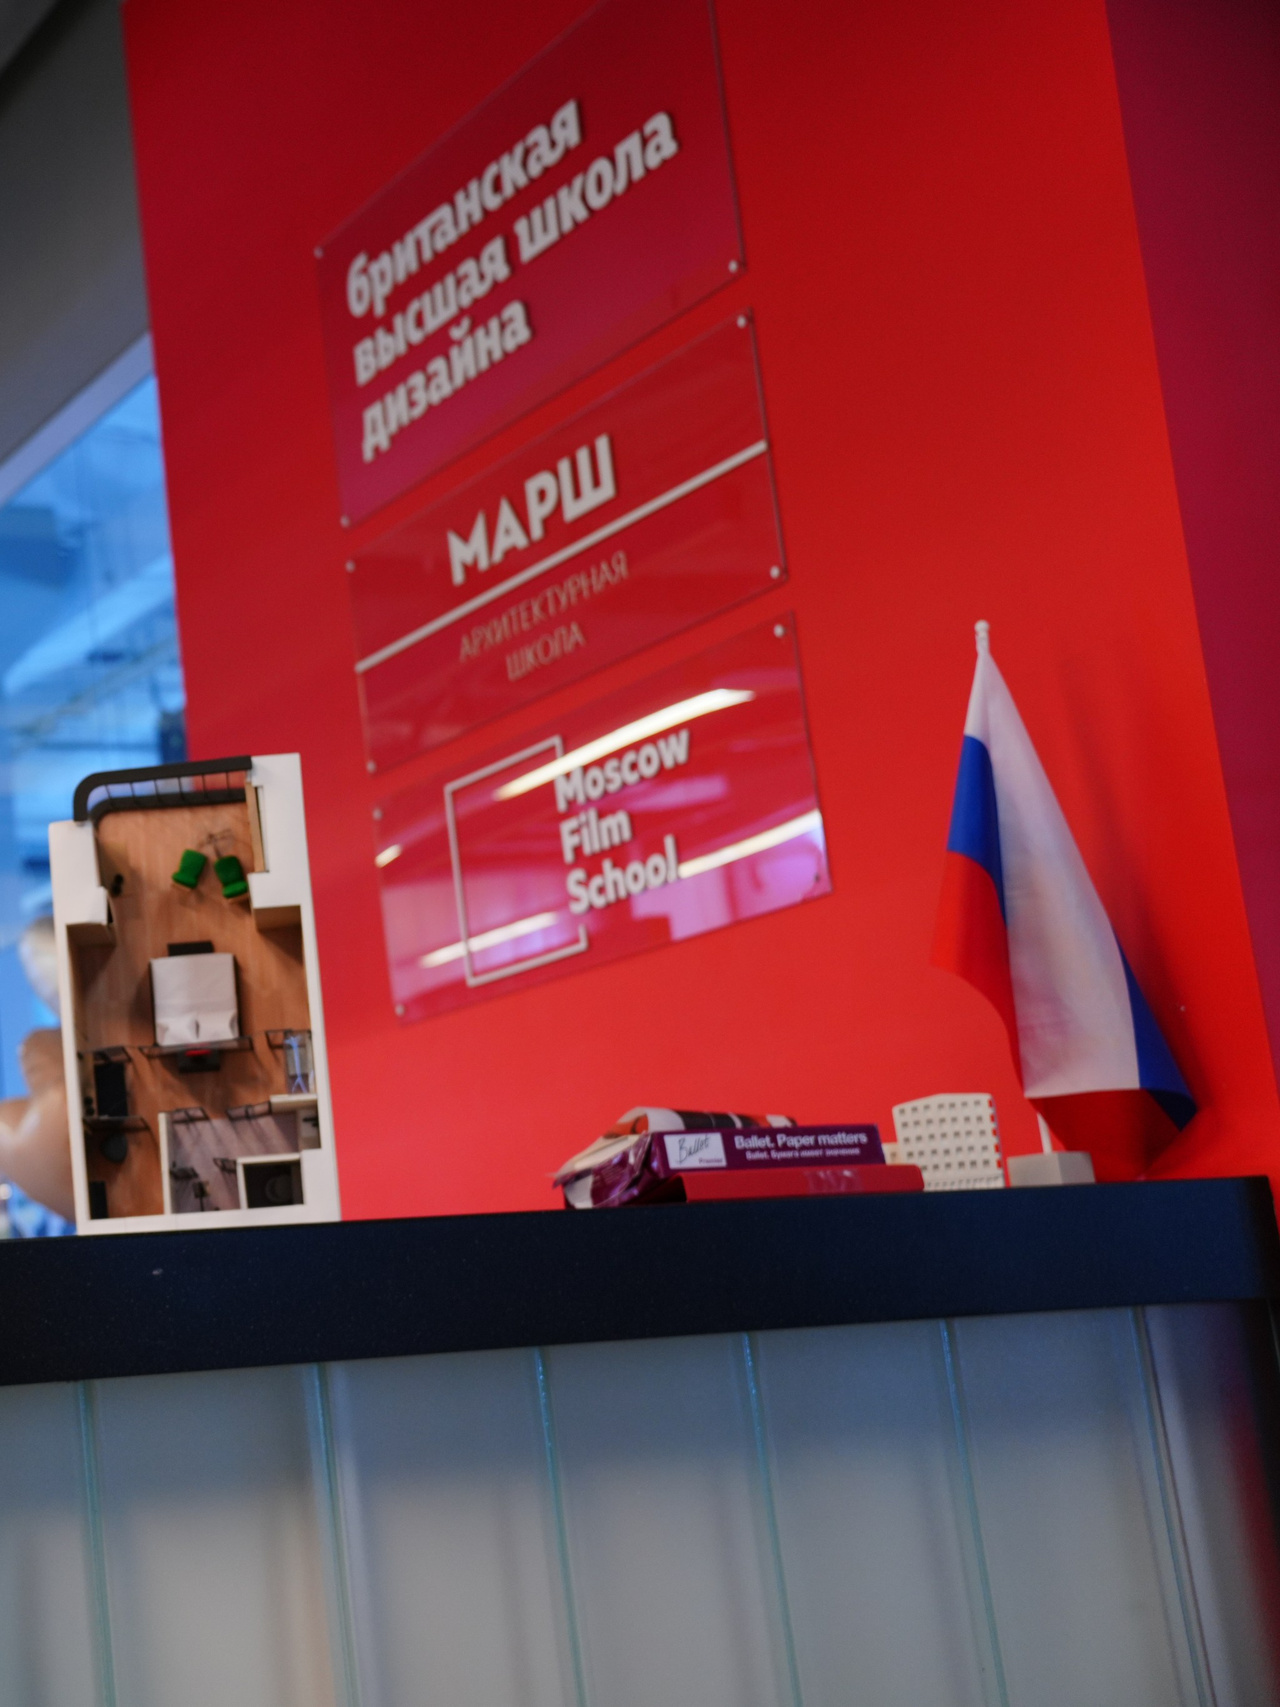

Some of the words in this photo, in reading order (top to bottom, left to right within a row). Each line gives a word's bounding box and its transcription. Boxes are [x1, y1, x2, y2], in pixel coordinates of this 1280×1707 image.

[346, 98, 582, 318] британская
[353, 235, 512, 388] высшая
[513, 110, 679, 264] школа
[362, 300, 533, 464] дизайна
[446, 433, 617, 587] МАРШ
[459, 550, 629, 662] АРХИТЕКТУРНАЯ
[506, 621, 587, 682] ШКОЛА
[554, 729, 690, 813] Moscow
[560, 807, 632, 864] Film
[566, 834, 680, 915] School
[734, 1134, 775, 1150] Ballet.
[776, 1133, 816, 1149] Paper
[817, 1131, 868, 1146] matters
